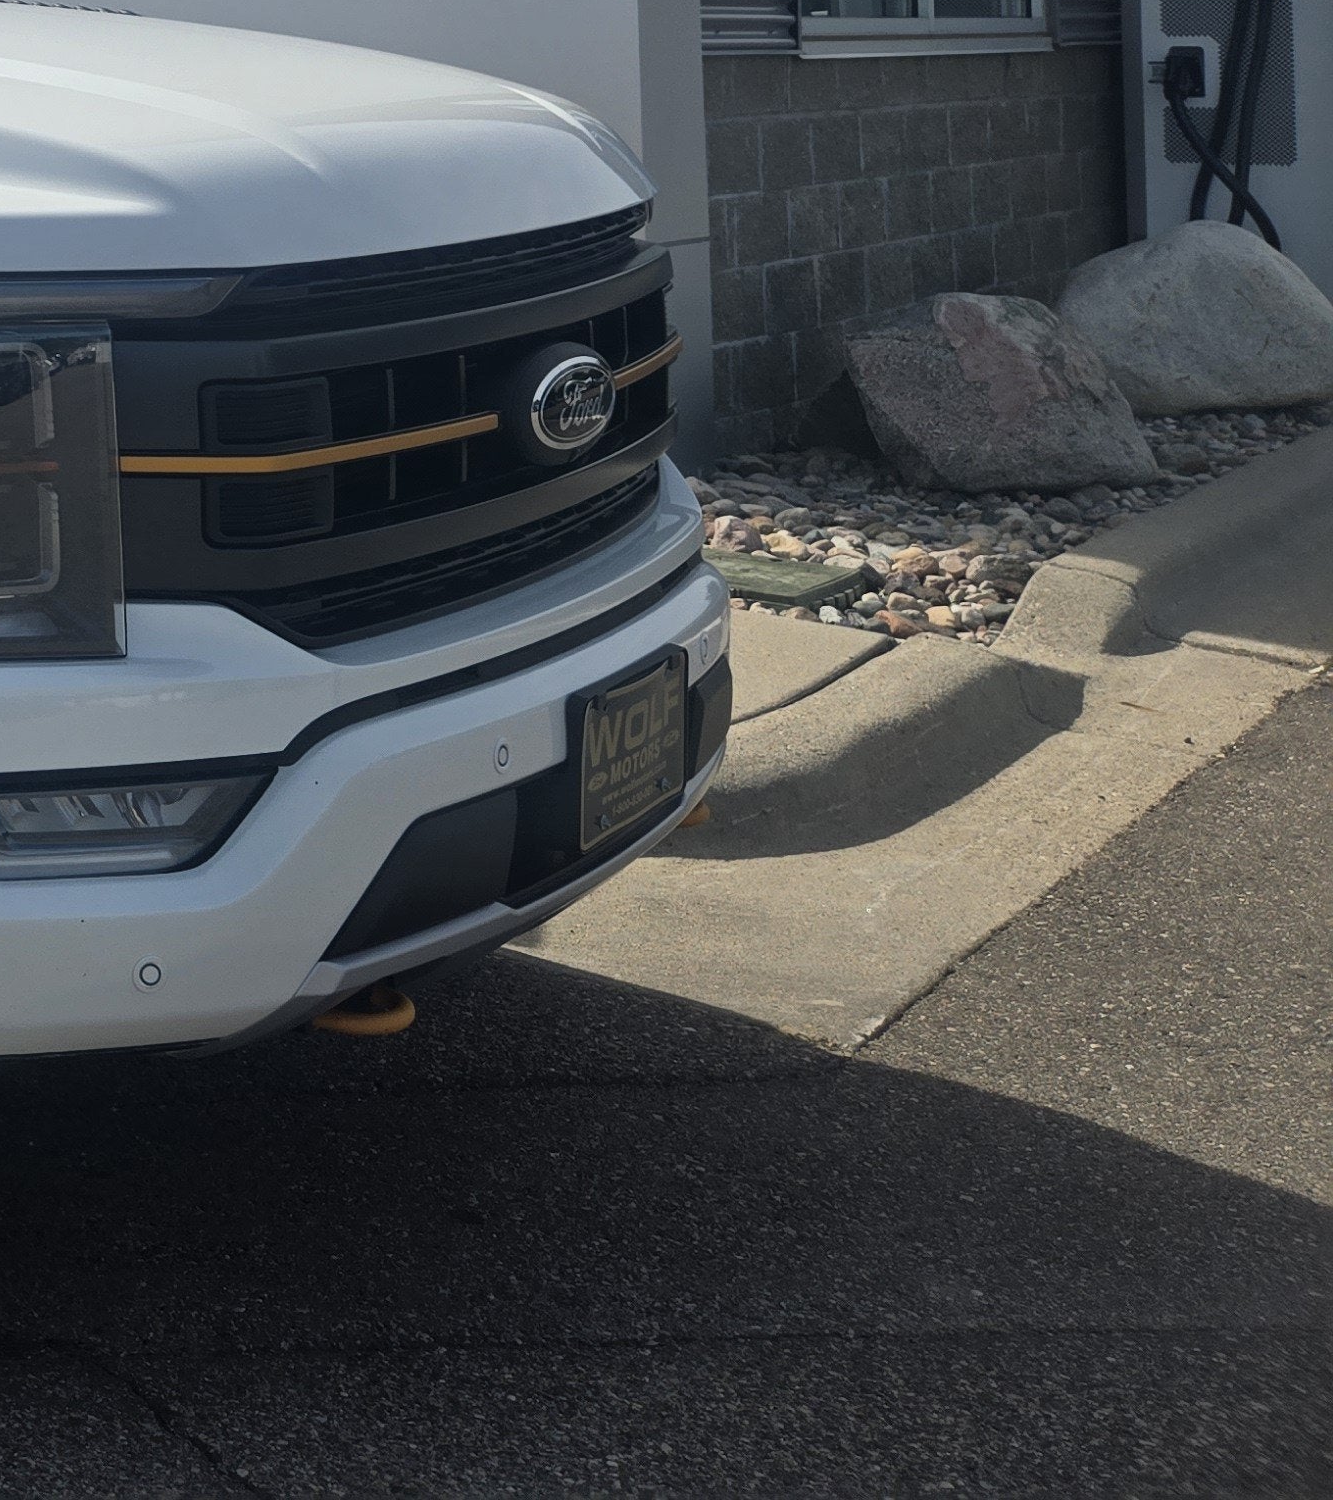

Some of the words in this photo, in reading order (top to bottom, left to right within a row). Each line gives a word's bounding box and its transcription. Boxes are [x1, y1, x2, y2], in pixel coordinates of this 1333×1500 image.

[559, 377, 605, 432] Ford
[586, 673, 681, 768] WOLF
[610, 739, 661, 786] MOTORS
